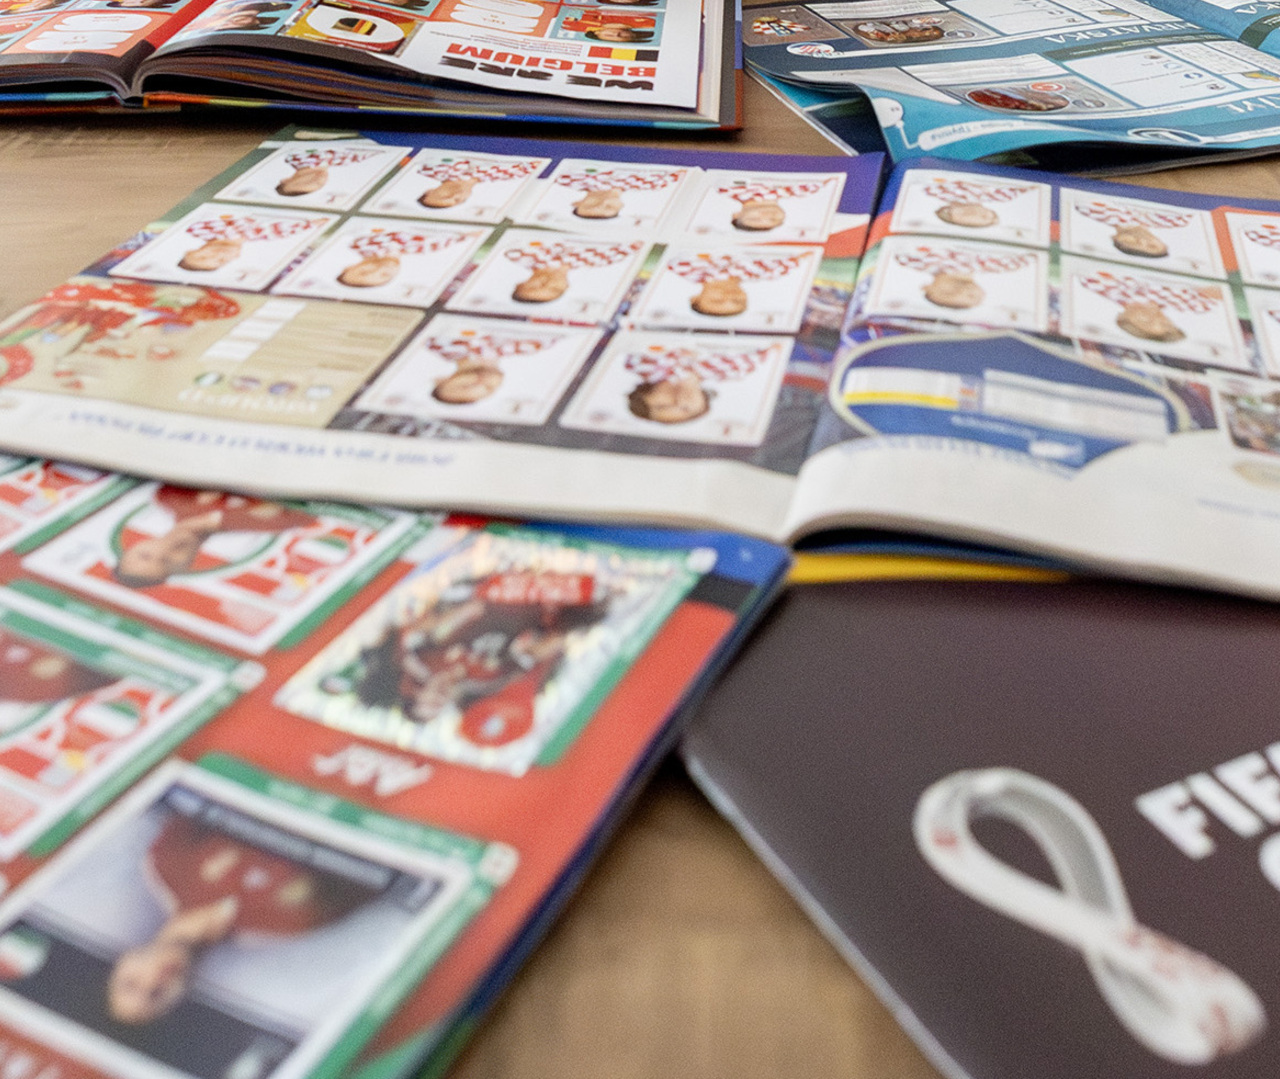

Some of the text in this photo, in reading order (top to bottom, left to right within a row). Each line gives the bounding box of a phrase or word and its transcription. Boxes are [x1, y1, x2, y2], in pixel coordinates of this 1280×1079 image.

[439, 56, 654, 91] WE ARE
[446, 43, 656, 77] BELGIUM
